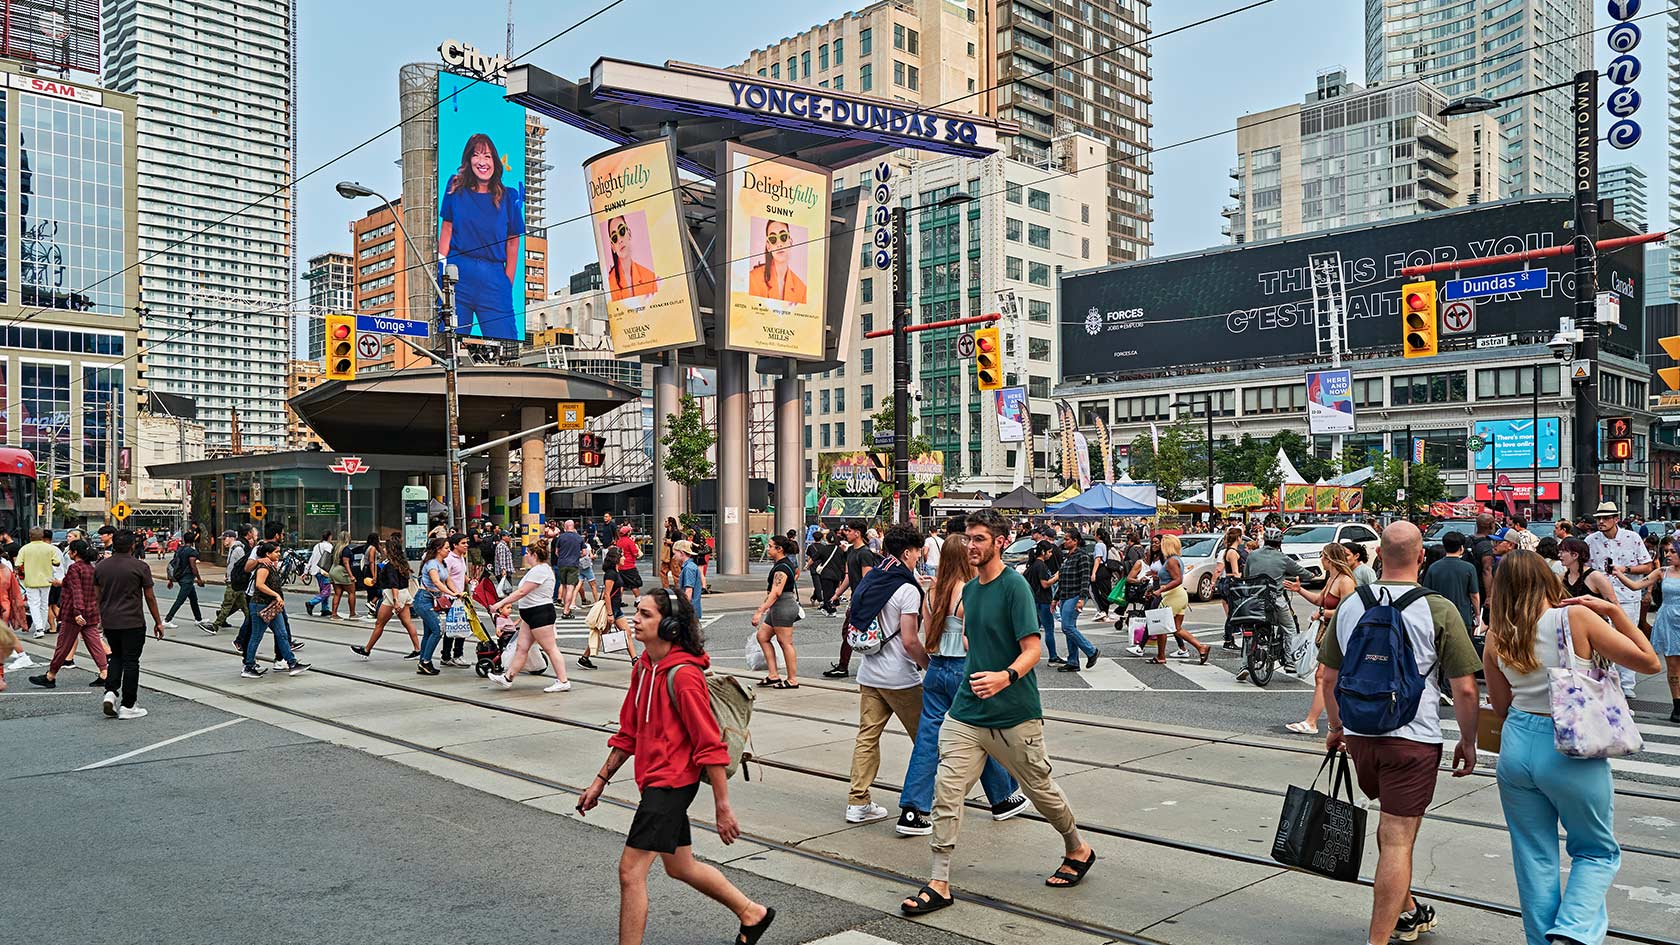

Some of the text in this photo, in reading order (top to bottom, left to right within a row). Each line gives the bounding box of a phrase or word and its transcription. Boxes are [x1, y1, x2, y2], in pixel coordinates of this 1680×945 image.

[441, 39, 507, 78] Cityt
[31, 79, 76, 97] SAM
[729, 81, 979, 145] YONGE-DUNDAS SQ
[1578, 81, 1591, 191] DOWNTOWN
[589, 163, 651, 200] Delightfully
[742, 170, 819, 209] Delightfully
[604, 199, 627, 213] SUNNY
[766, 204, 794, 218] SUNNY
[1343, 257, 1377, 285] IS
[1463, 272, 1530, 294] Dundas St
[1611, 270, 1634, 299] Canada
[1106, 307, 1144, 321] FORCES
[1226, 302, 1316, 334] C'EST
[374, 317, 405, 333] Yonge
[623, 323, 650, 336] VAUGHAN
[762, 325, 795, 337] VAUGHAN
[628, 331, 646, 341] MILLS
[768, 332, 790, 342] MILLS
[1480, 336, 1504, 347] astral
[1326, 376, 1347, 384] HERE
[1330, 382, 1348, 390] AND
[1497, 433, 1518, 441] There's
[1617, 442, 1628, 458] 0
[831, 464, 853, 480] JOLLY
[846, 478, 879, 493] SLUSHY
[1325, 797, 1354, 821] GEN
[1324, 840, 1351, 863] SPR
[1312, 851, 1337, 873] ING
